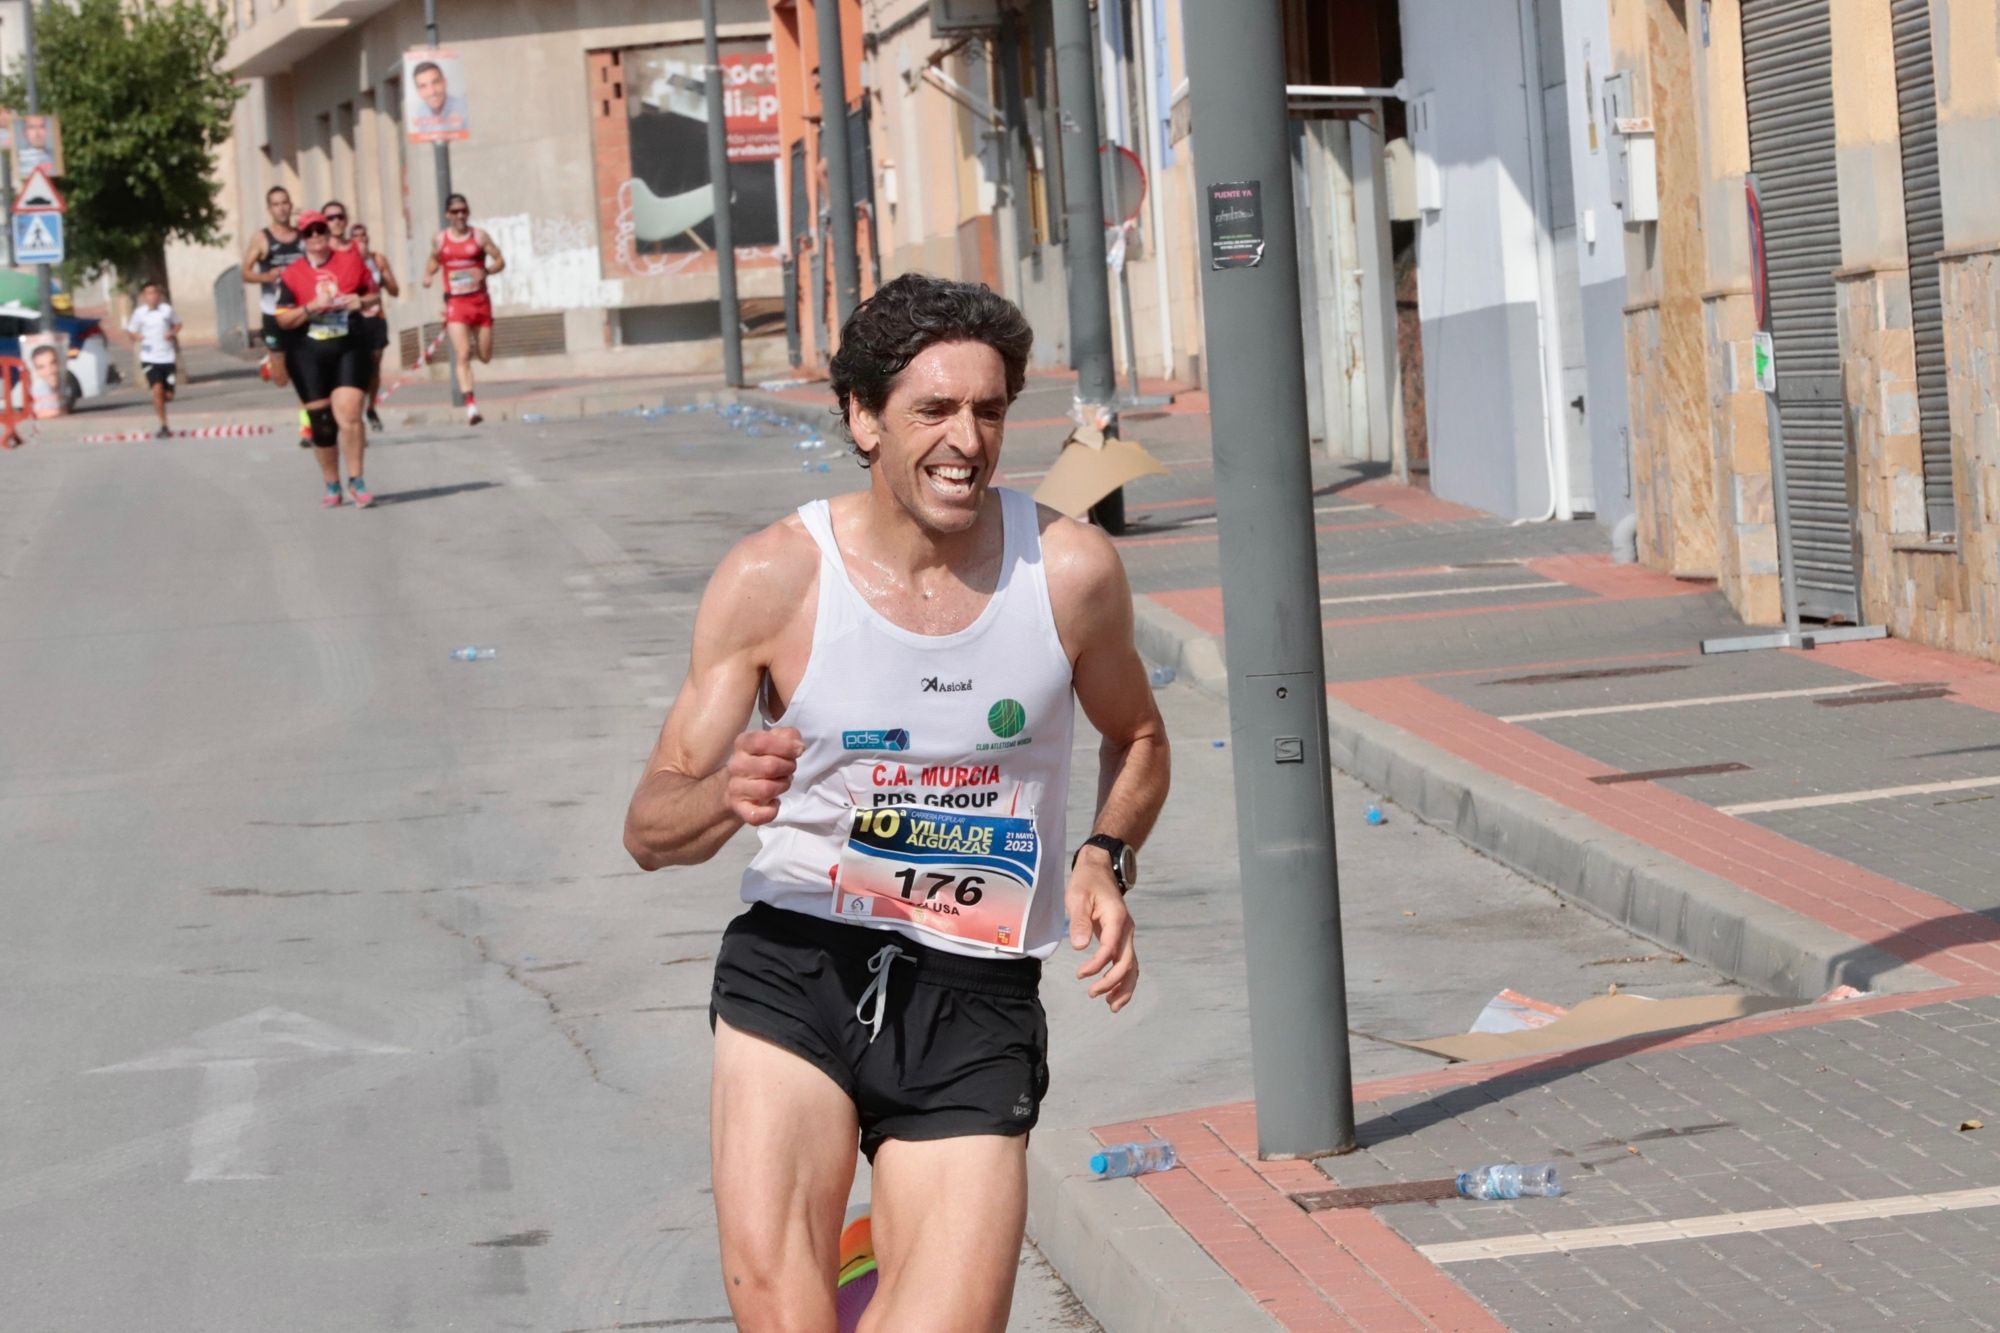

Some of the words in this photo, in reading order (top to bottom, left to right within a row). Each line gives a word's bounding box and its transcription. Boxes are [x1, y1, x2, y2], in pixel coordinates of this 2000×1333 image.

[939, 681, 973, 692] Asioka
[846, 731, 880, 748] pds
[976, 743, 989, 751] CLUB
[990, 741, 1016, 750] ATLETISMO
[872, 765, 913, 787] C.A.
[921, 765, 1000, 788] MURCIA
[873, 792, 917, 807] PDS
[924, 791, 998, 808] GROUP
[911, 811, 937, 821] CARRERA
[938, 814, 966, 824] POPULAR
[911, 819, 963, 841] VILLA
[968, 826, 993, 843] DE
[1006, 832, 1015, 840] 21
[1016, 832, 1034, 841] MAYO
[905, 834, 991, 855] ALGUAZAS
[1004, 840, 1034, 852] 2023
[894, 867, 986, 906] 176
